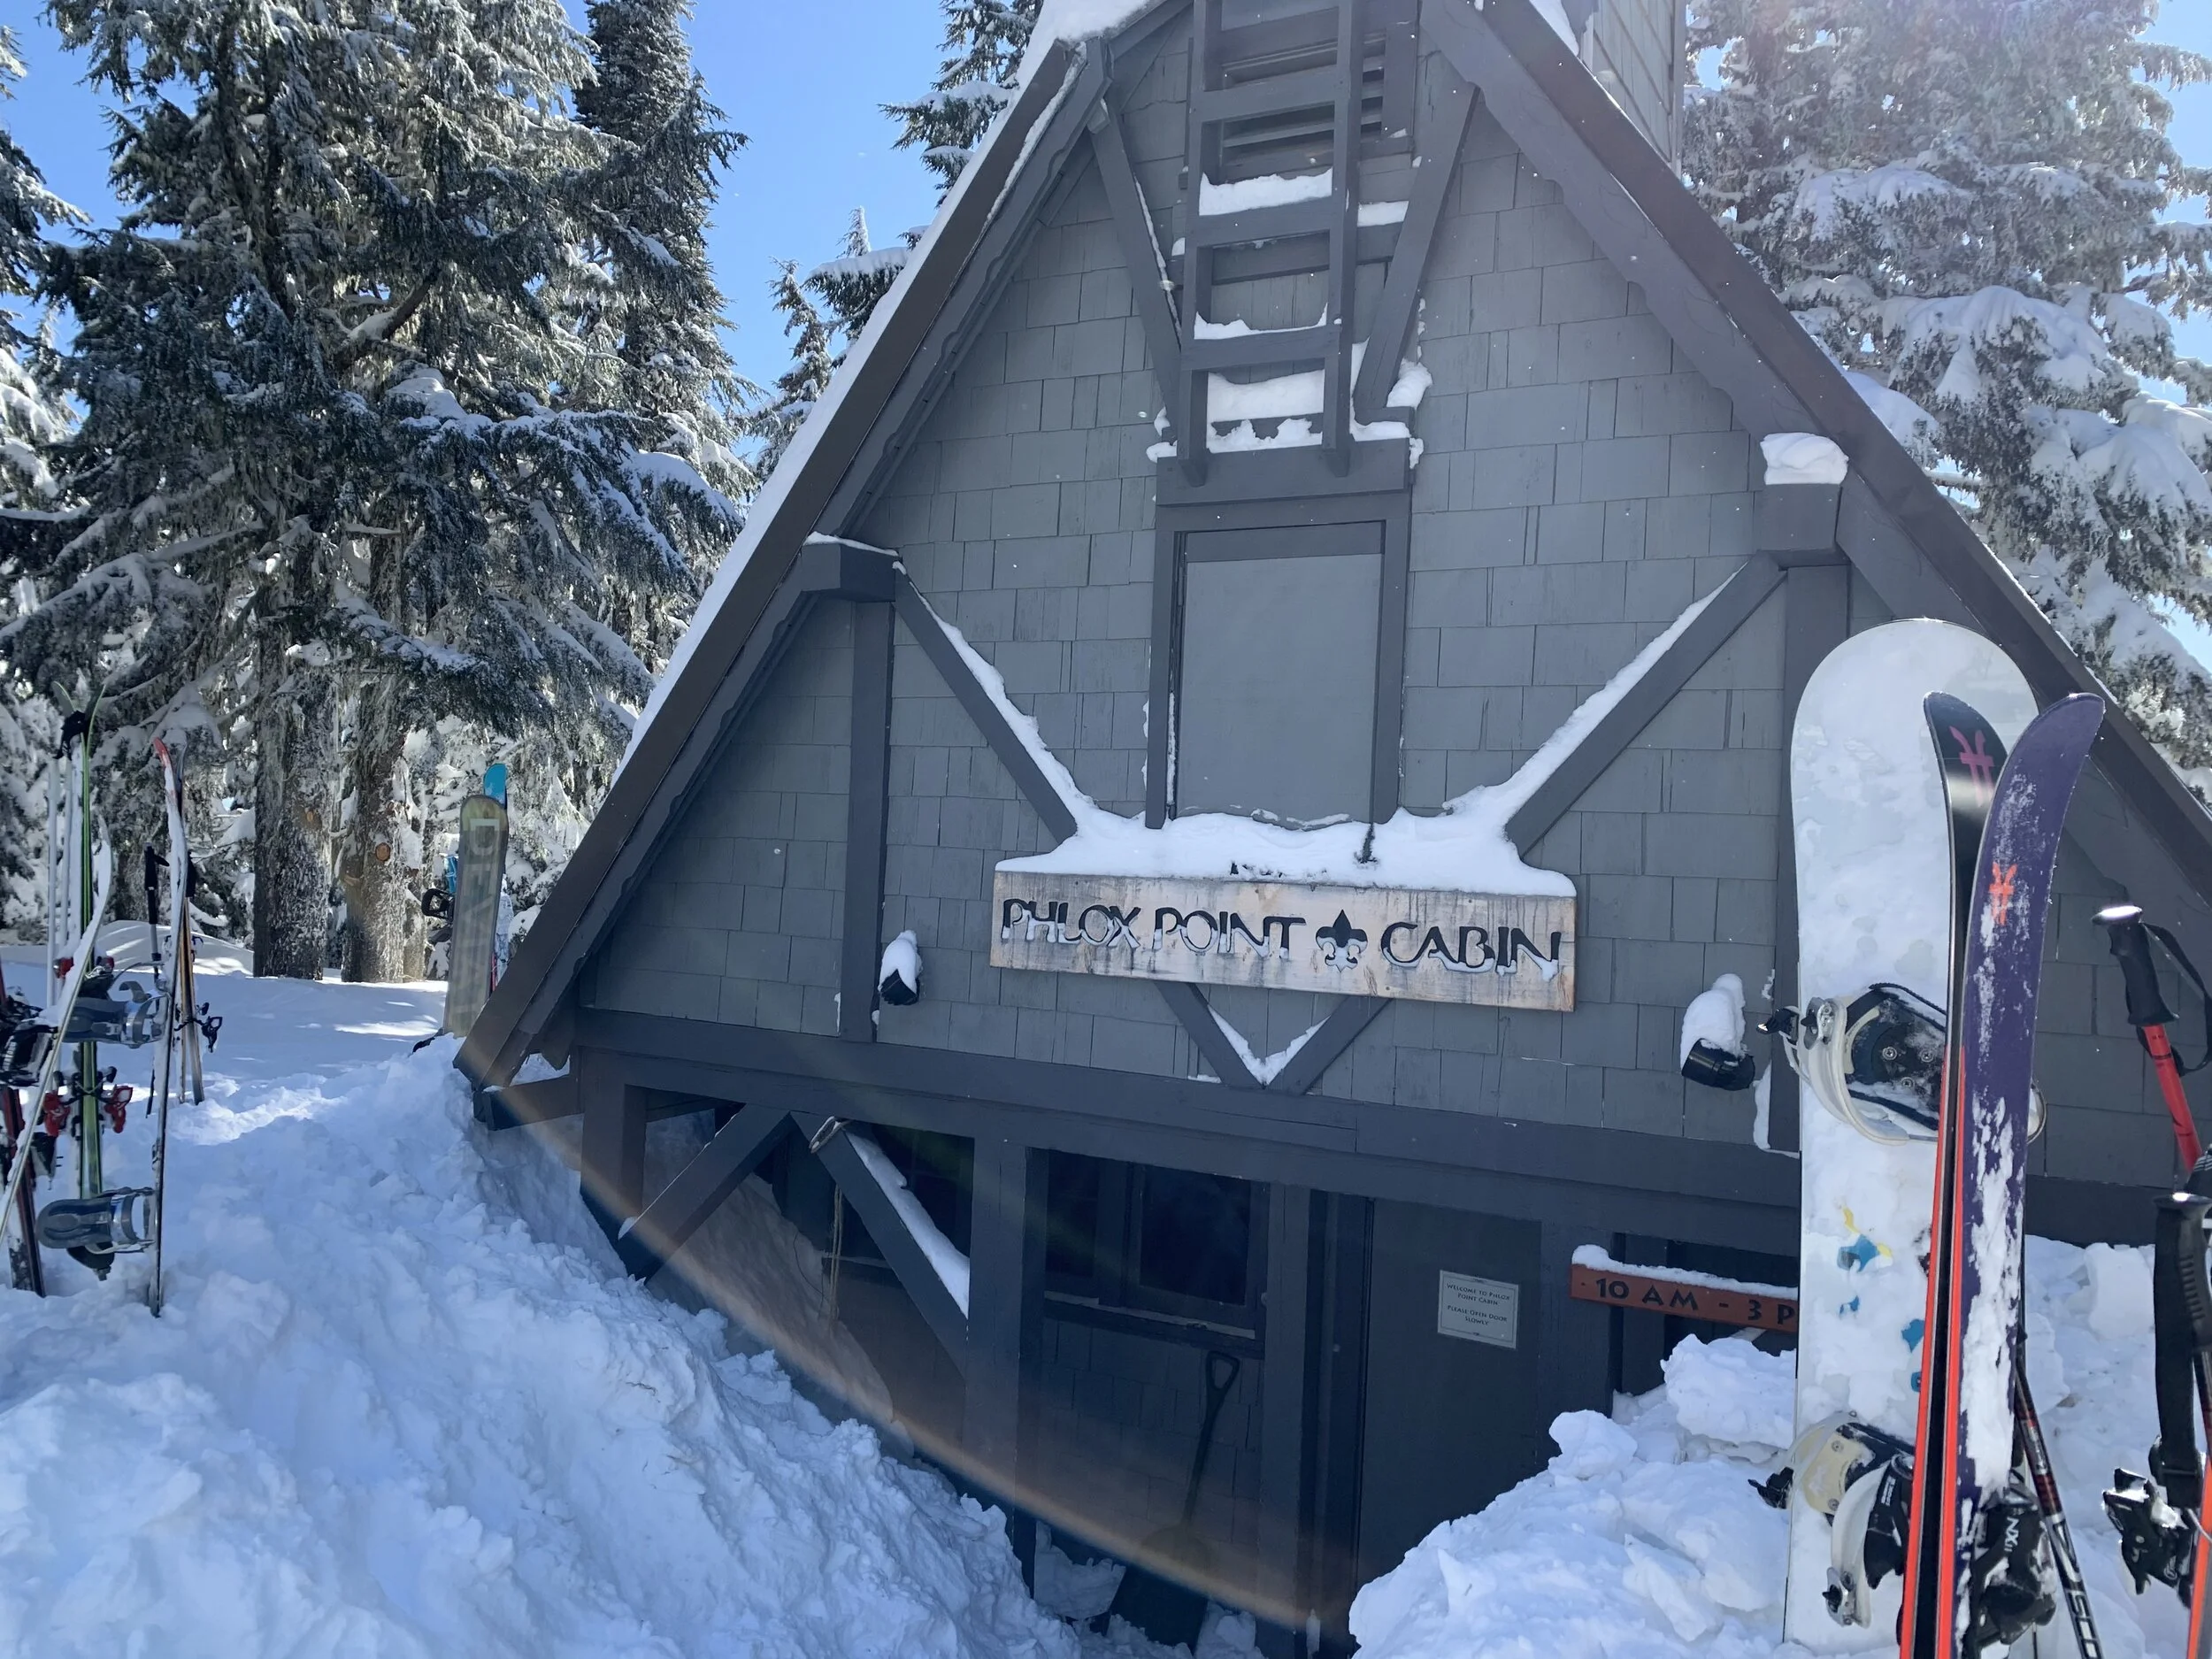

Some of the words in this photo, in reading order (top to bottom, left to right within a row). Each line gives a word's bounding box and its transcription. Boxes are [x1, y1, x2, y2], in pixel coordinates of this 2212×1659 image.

[1002, 898, 1141, 949] PHLOX
[1152, 906, 1307, 959] POINT
[1381, 921, 1562, 980] CABIN
[1448, 1283, 1476, 1294] WELCOME
[1595, 1277, 1630, 1300] 10
[1641, 1284, 1699, 1311] AM
[1747, 1299, 1763, 1321] 3
[1777, 1303, 1796, 1325] P
[1448, 1305, 1467, 1314] PLEASE
